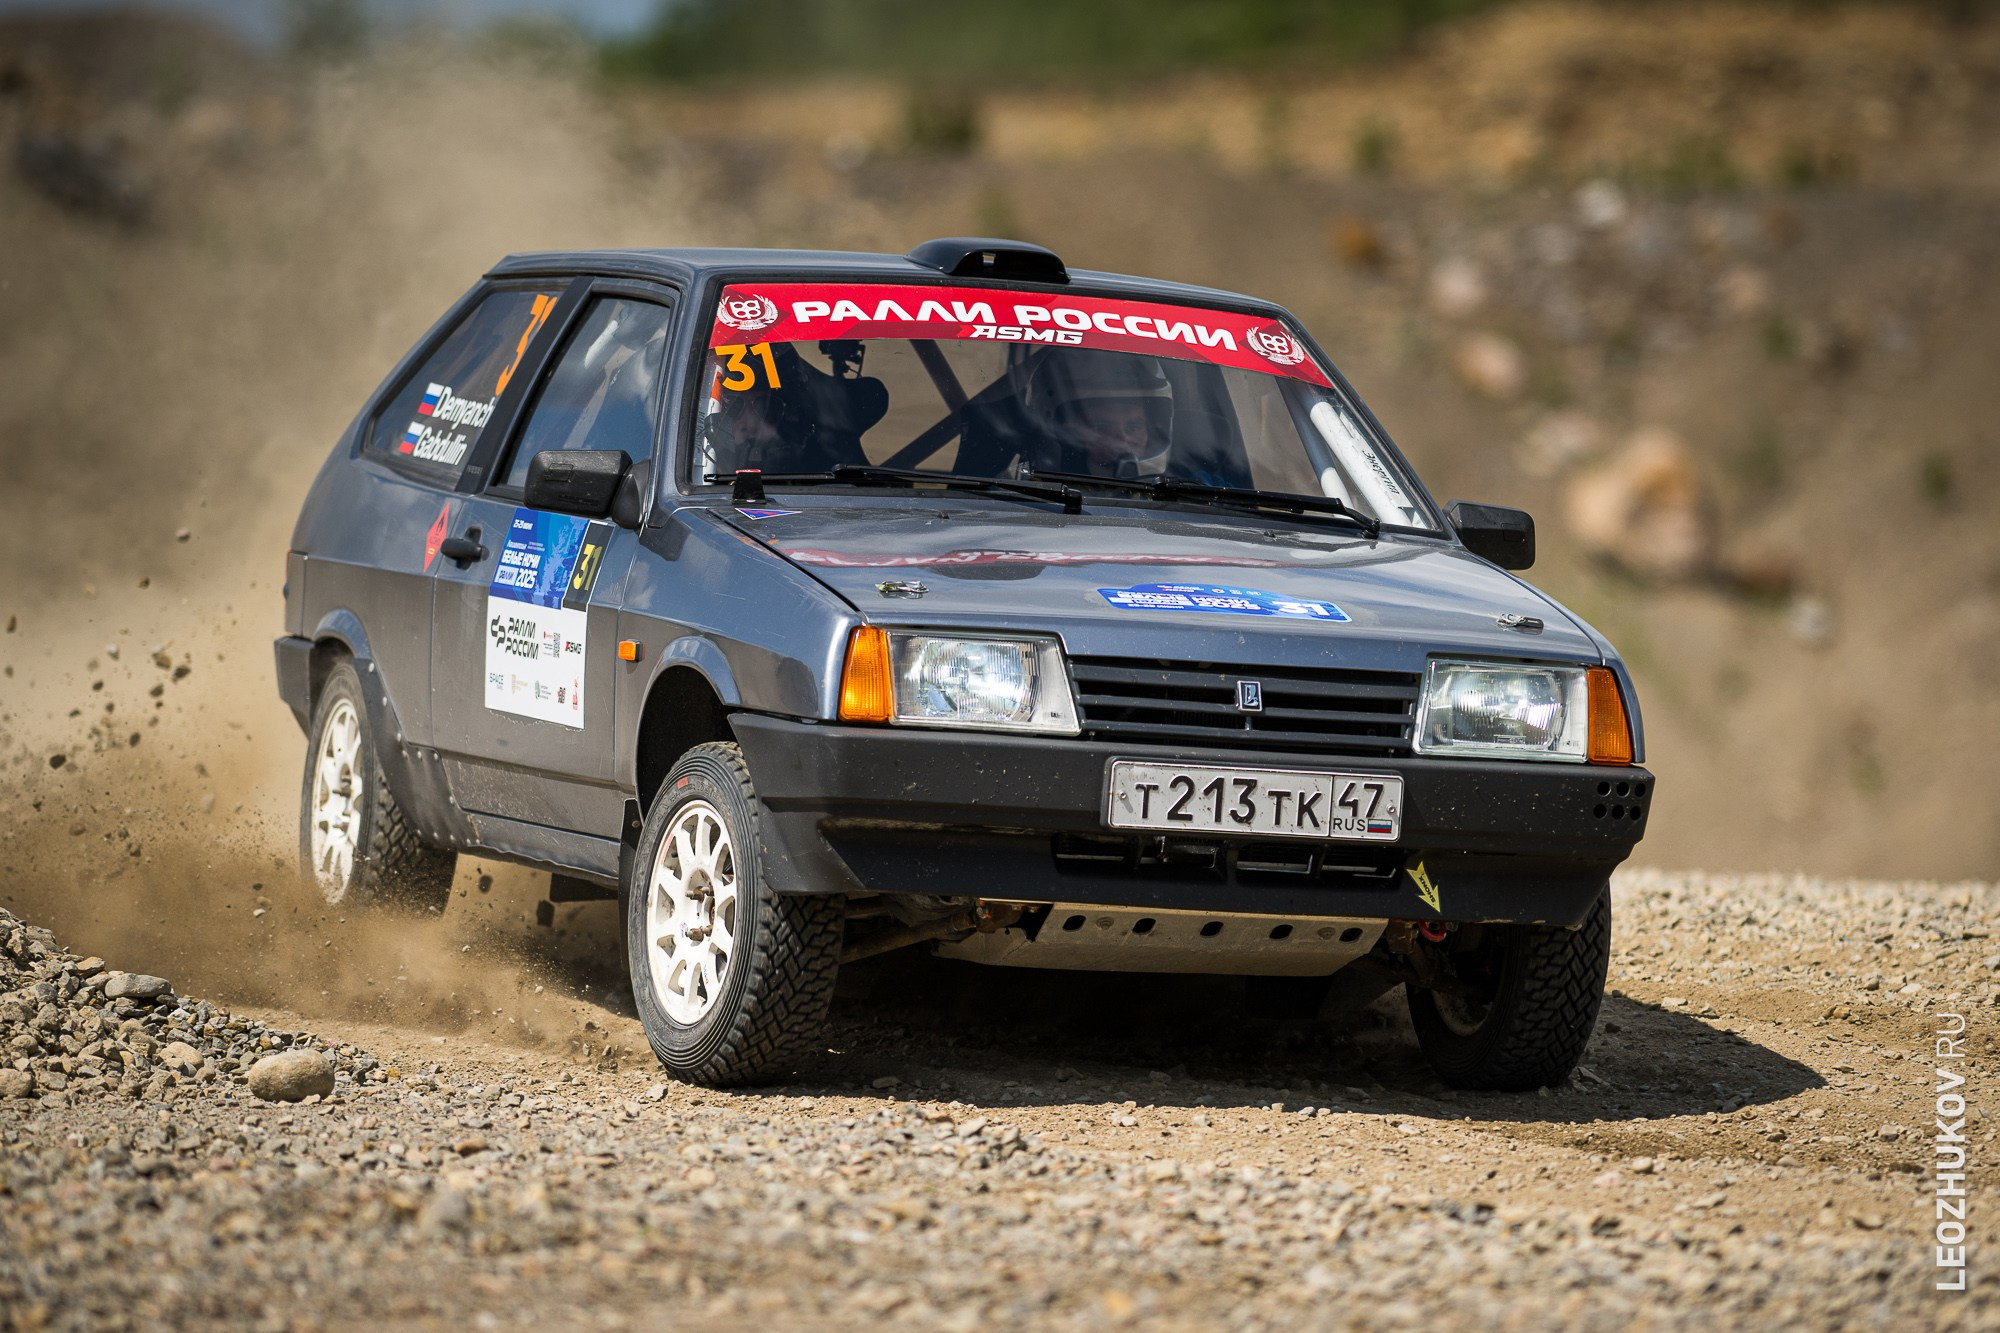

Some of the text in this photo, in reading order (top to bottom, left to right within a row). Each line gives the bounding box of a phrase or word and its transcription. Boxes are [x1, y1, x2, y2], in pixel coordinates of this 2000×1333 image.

[791, 300, 1238, 352] РАЛЛИ РОССИИ
[969, 324, 1084, 345] ASMG
[715, 342, 782, 392] 31
[412, 427, 468, 466] Gabdullin
[515, 568, 538, 589] 2025
[573, 543, 603, 591] 31
[1272, 600, 1334, 616] 31
[507, 617, 536, 639] РАЛЛИ
[505, 637, 539, 660] РОССИИ
[1338, 782, 1385, 819] 47
[1332, 817, 1366, 832] RUS
